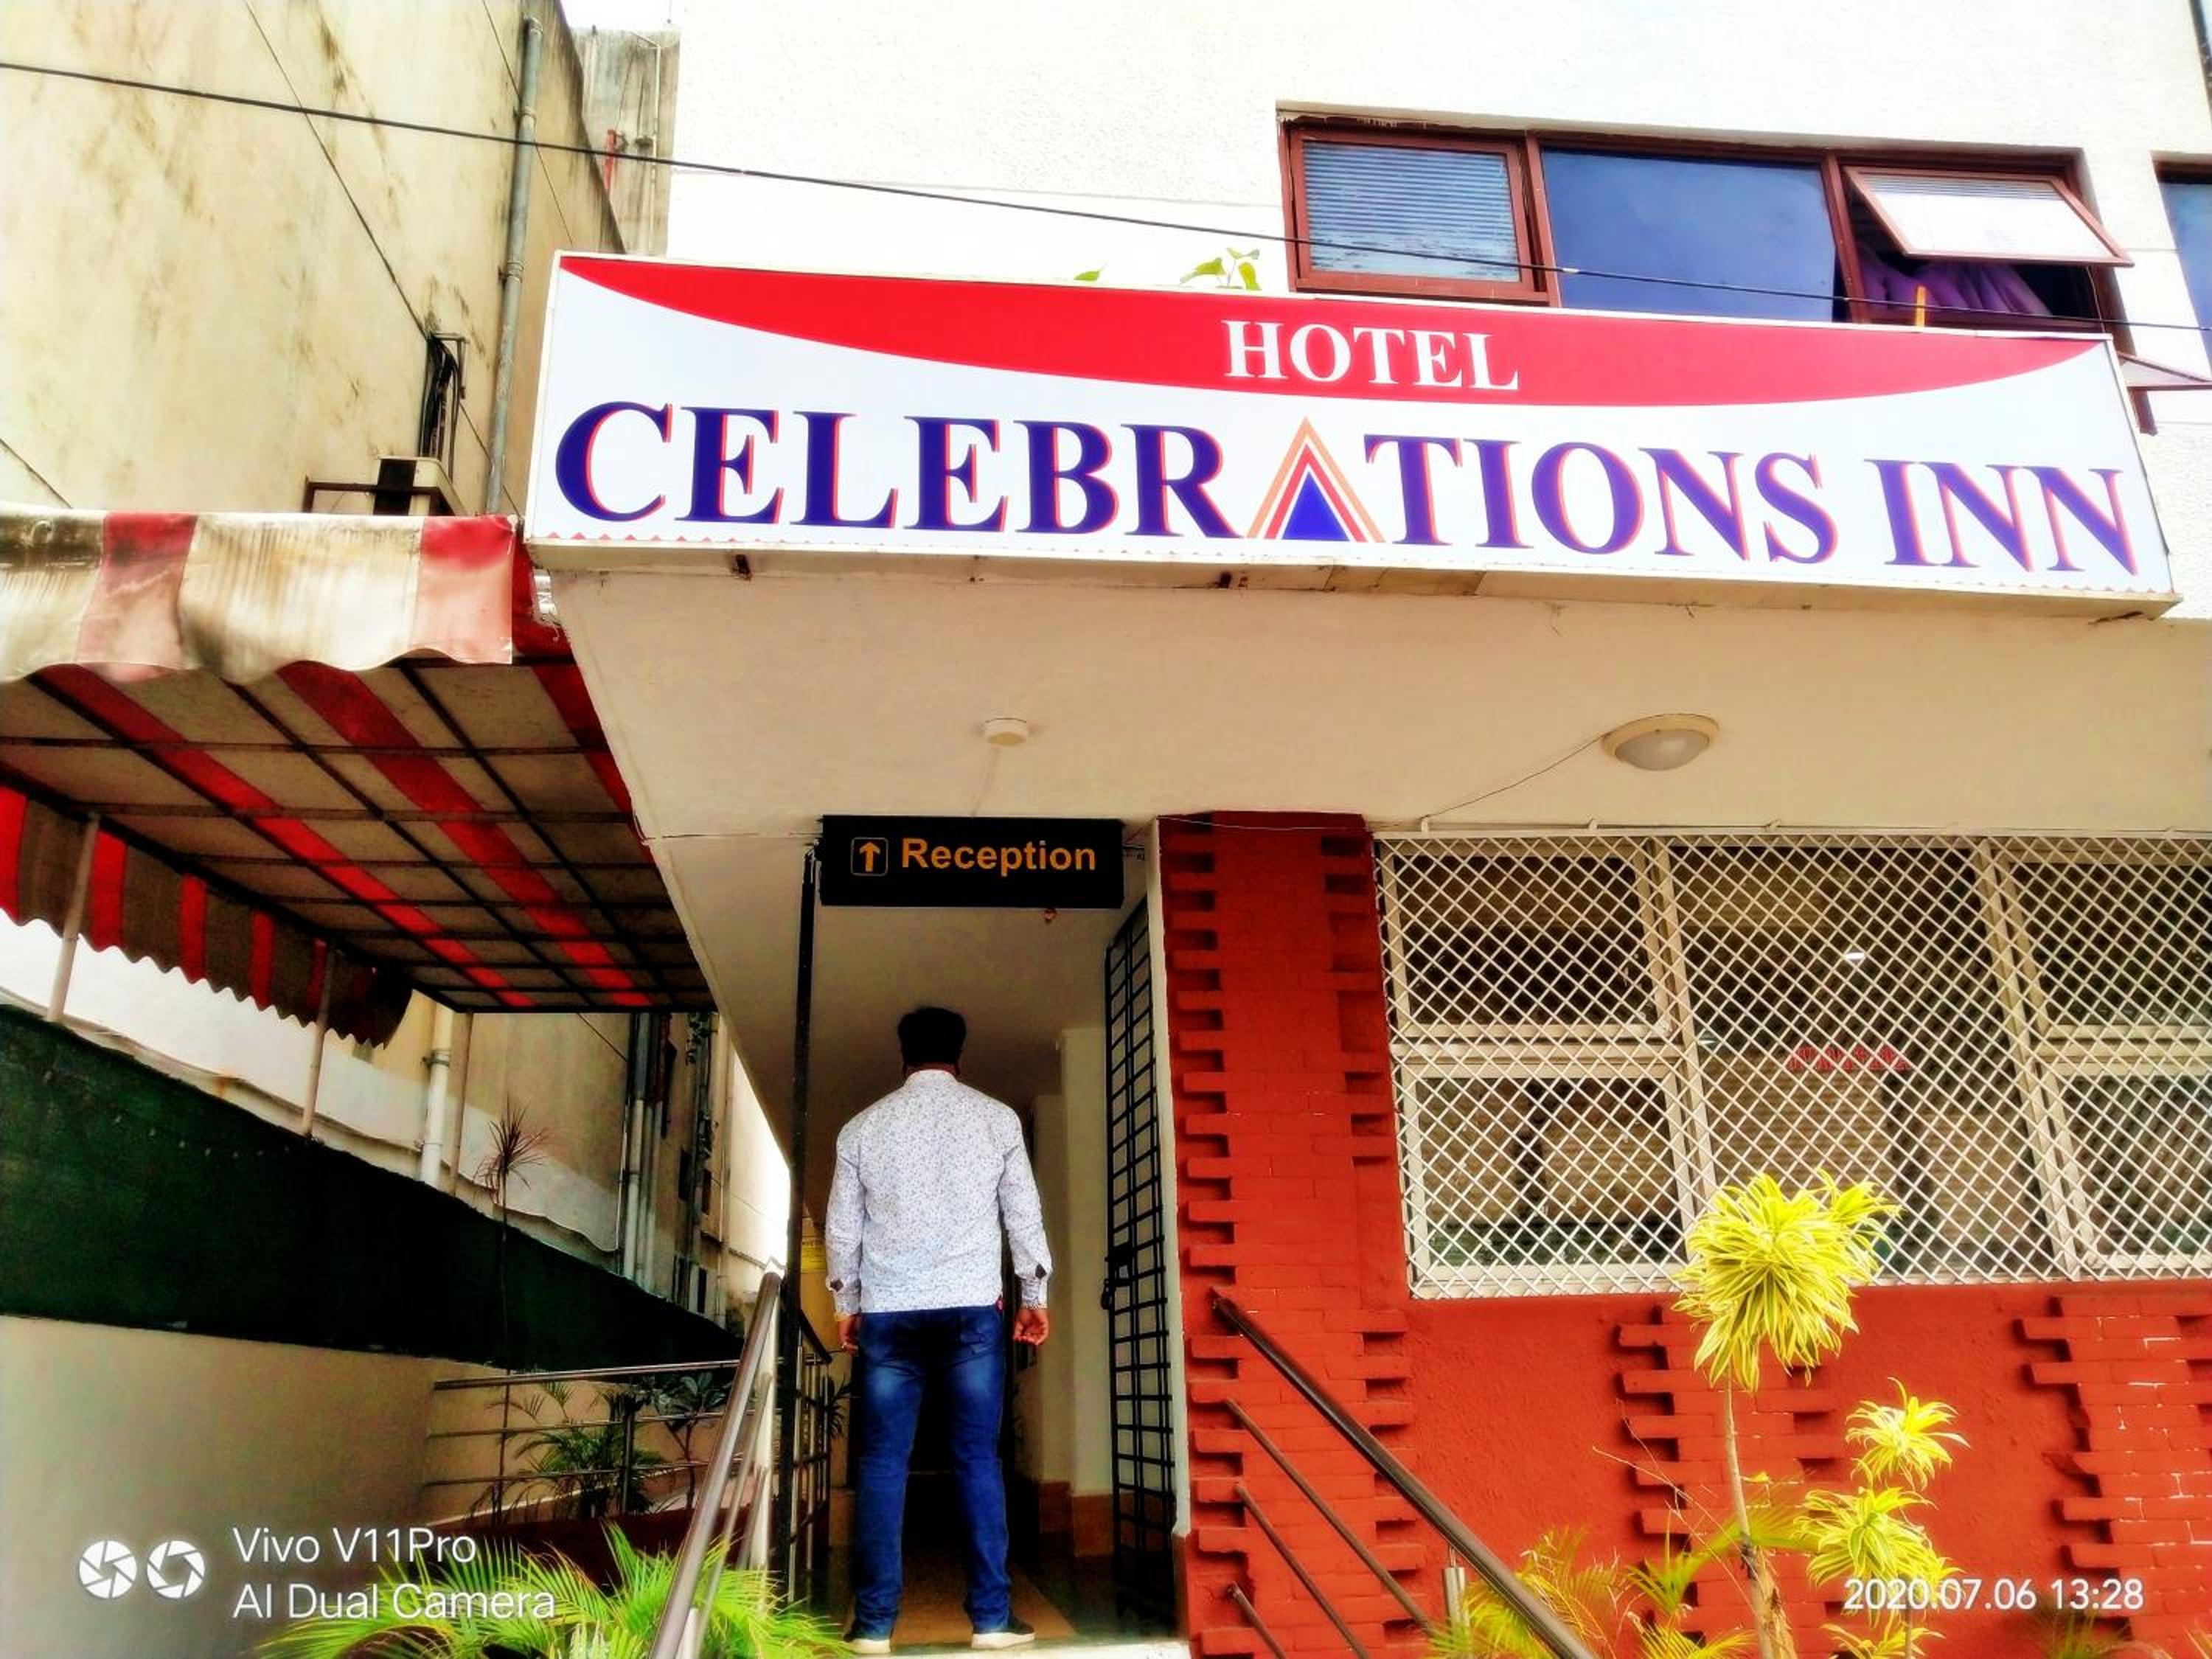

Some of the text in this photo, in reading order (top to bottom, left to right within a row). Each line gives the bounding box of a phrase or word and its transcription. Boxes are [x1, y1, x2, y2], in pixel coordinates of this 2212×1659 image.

[1225, 319, 1520, 393] HOTEL
[554, 400, 2140, 577] CELEBRATIONS INN
[902, 838, 1096, 877] Reception
